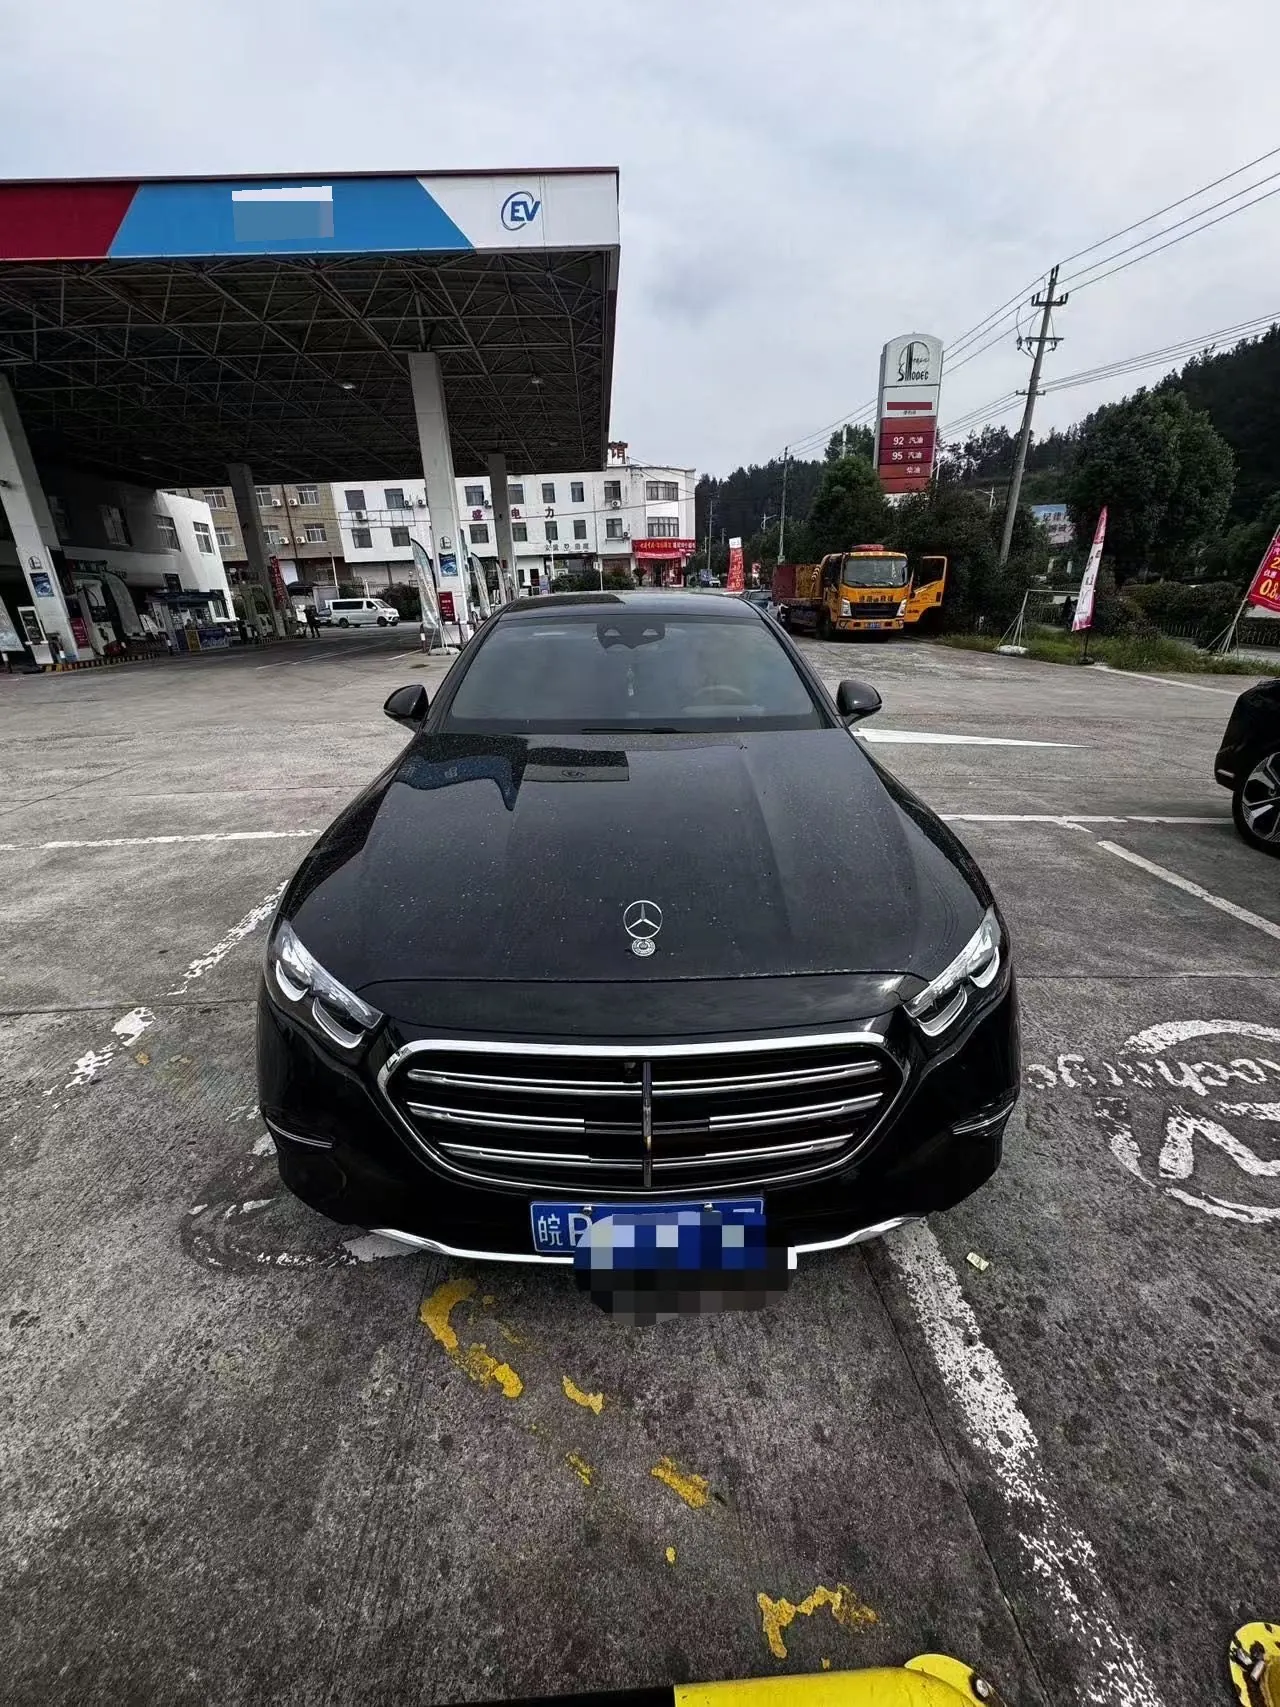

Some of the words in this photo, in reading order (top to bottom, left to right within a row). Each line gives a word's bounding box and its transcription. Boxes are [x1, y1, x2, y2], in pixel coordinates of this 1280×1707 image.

[510, 200, 541, 221] EV
[893, 436, 905, 446] 92
[892, 451, 903, 461] 95
